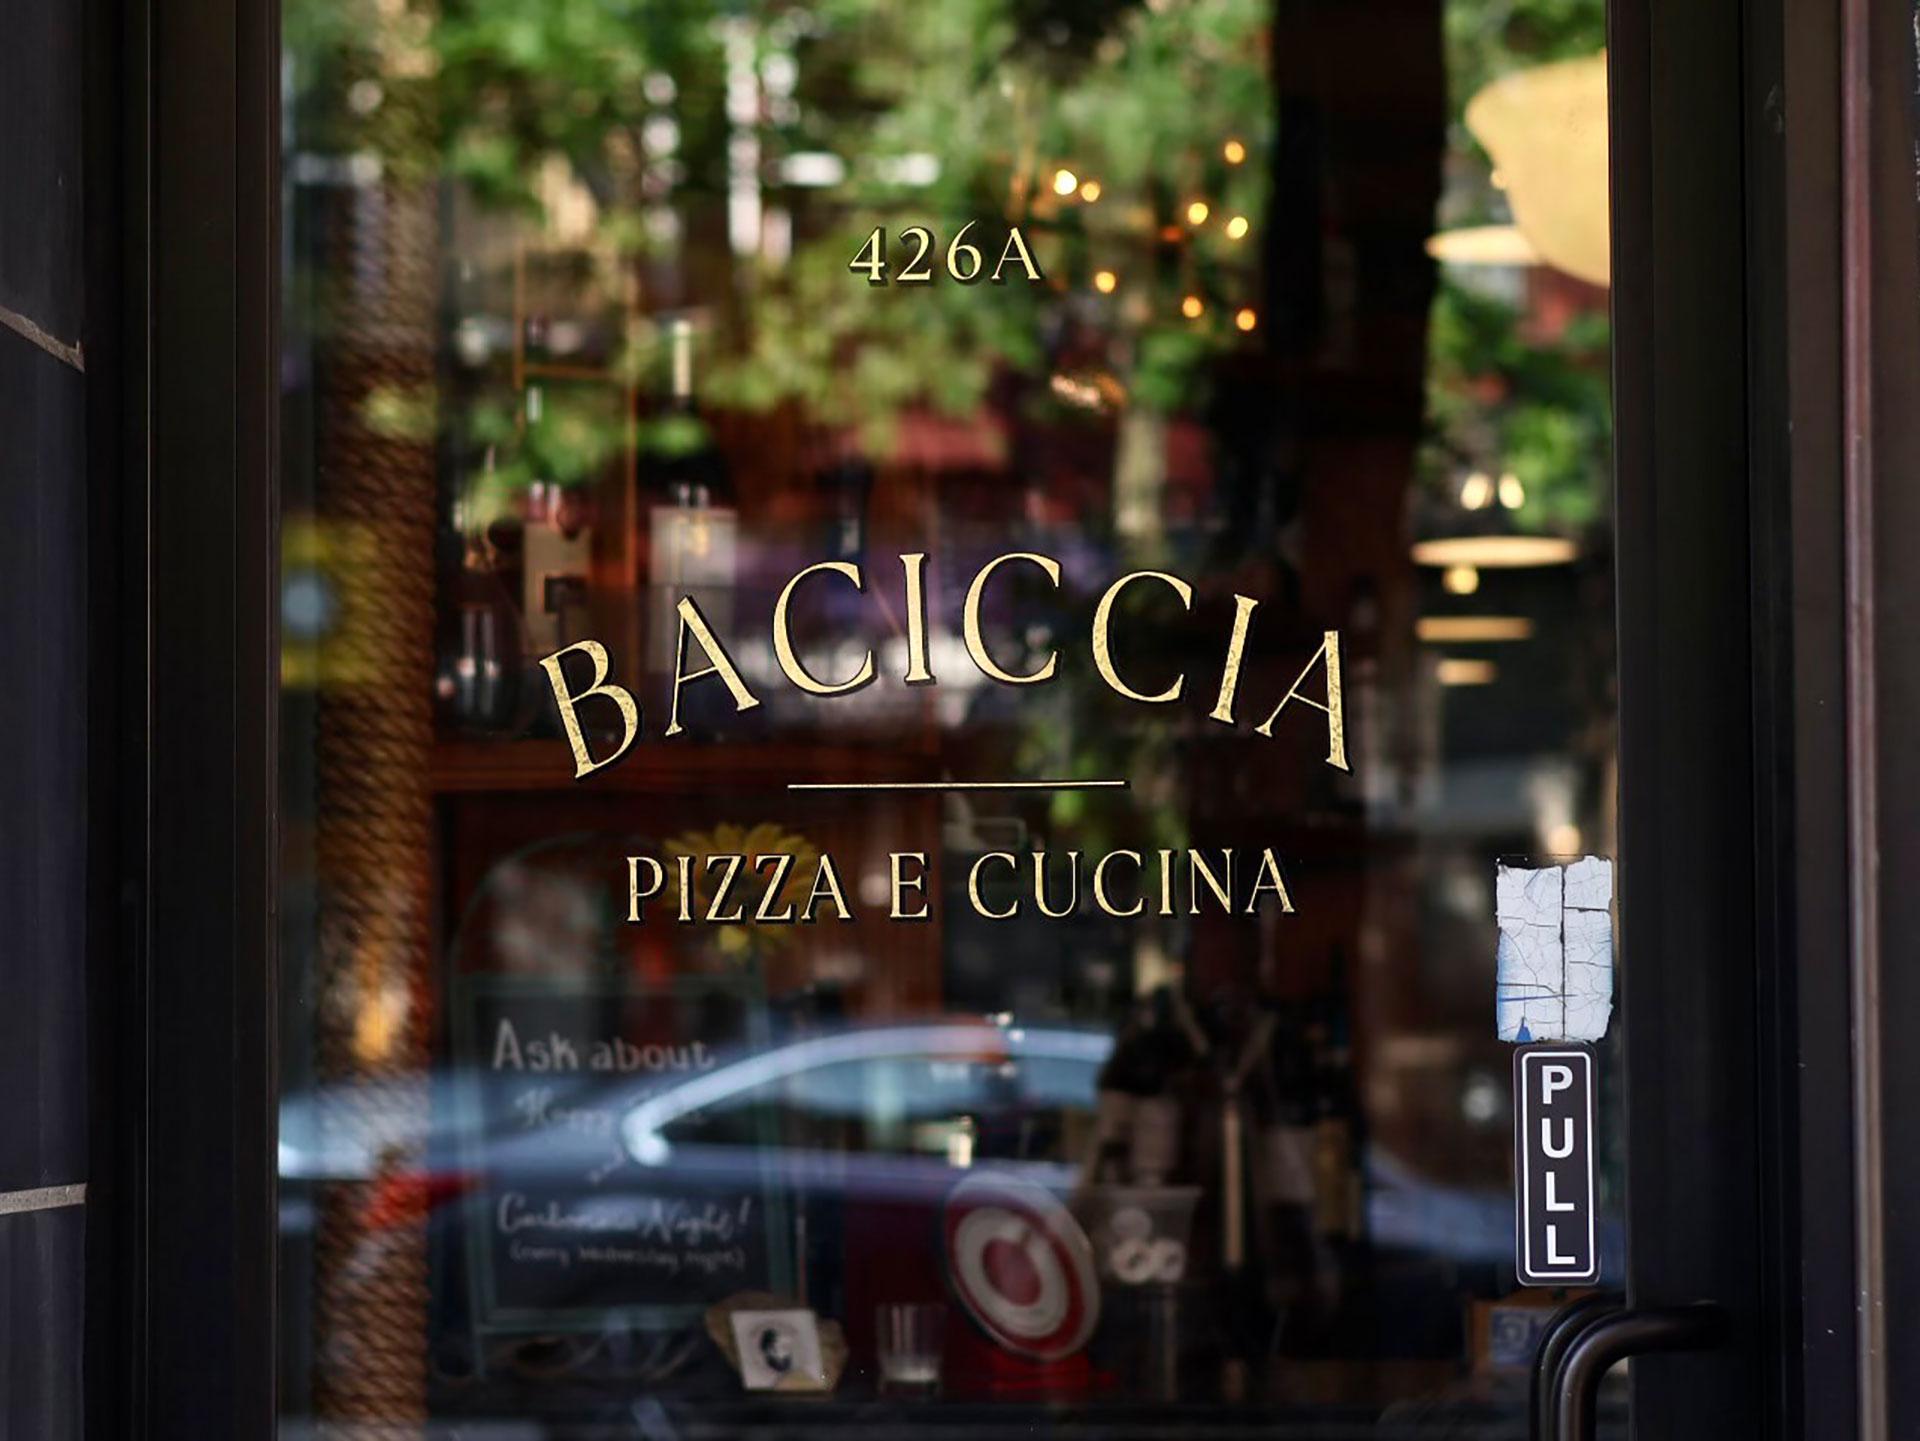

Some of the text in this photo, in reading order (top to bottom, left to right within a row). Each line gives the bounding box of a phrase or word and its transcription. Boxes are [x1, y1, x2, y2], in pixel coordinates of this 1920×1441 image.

[849, 219, 1041, 283] 426A
[538, 551, 1353, 779] BACICCIA
[626, 847, 1296, 922] PIZZA E CUCINA
[493, 1017, 717, 1072] Ask about
[1541, 1064, 1576, 1266] PULL
